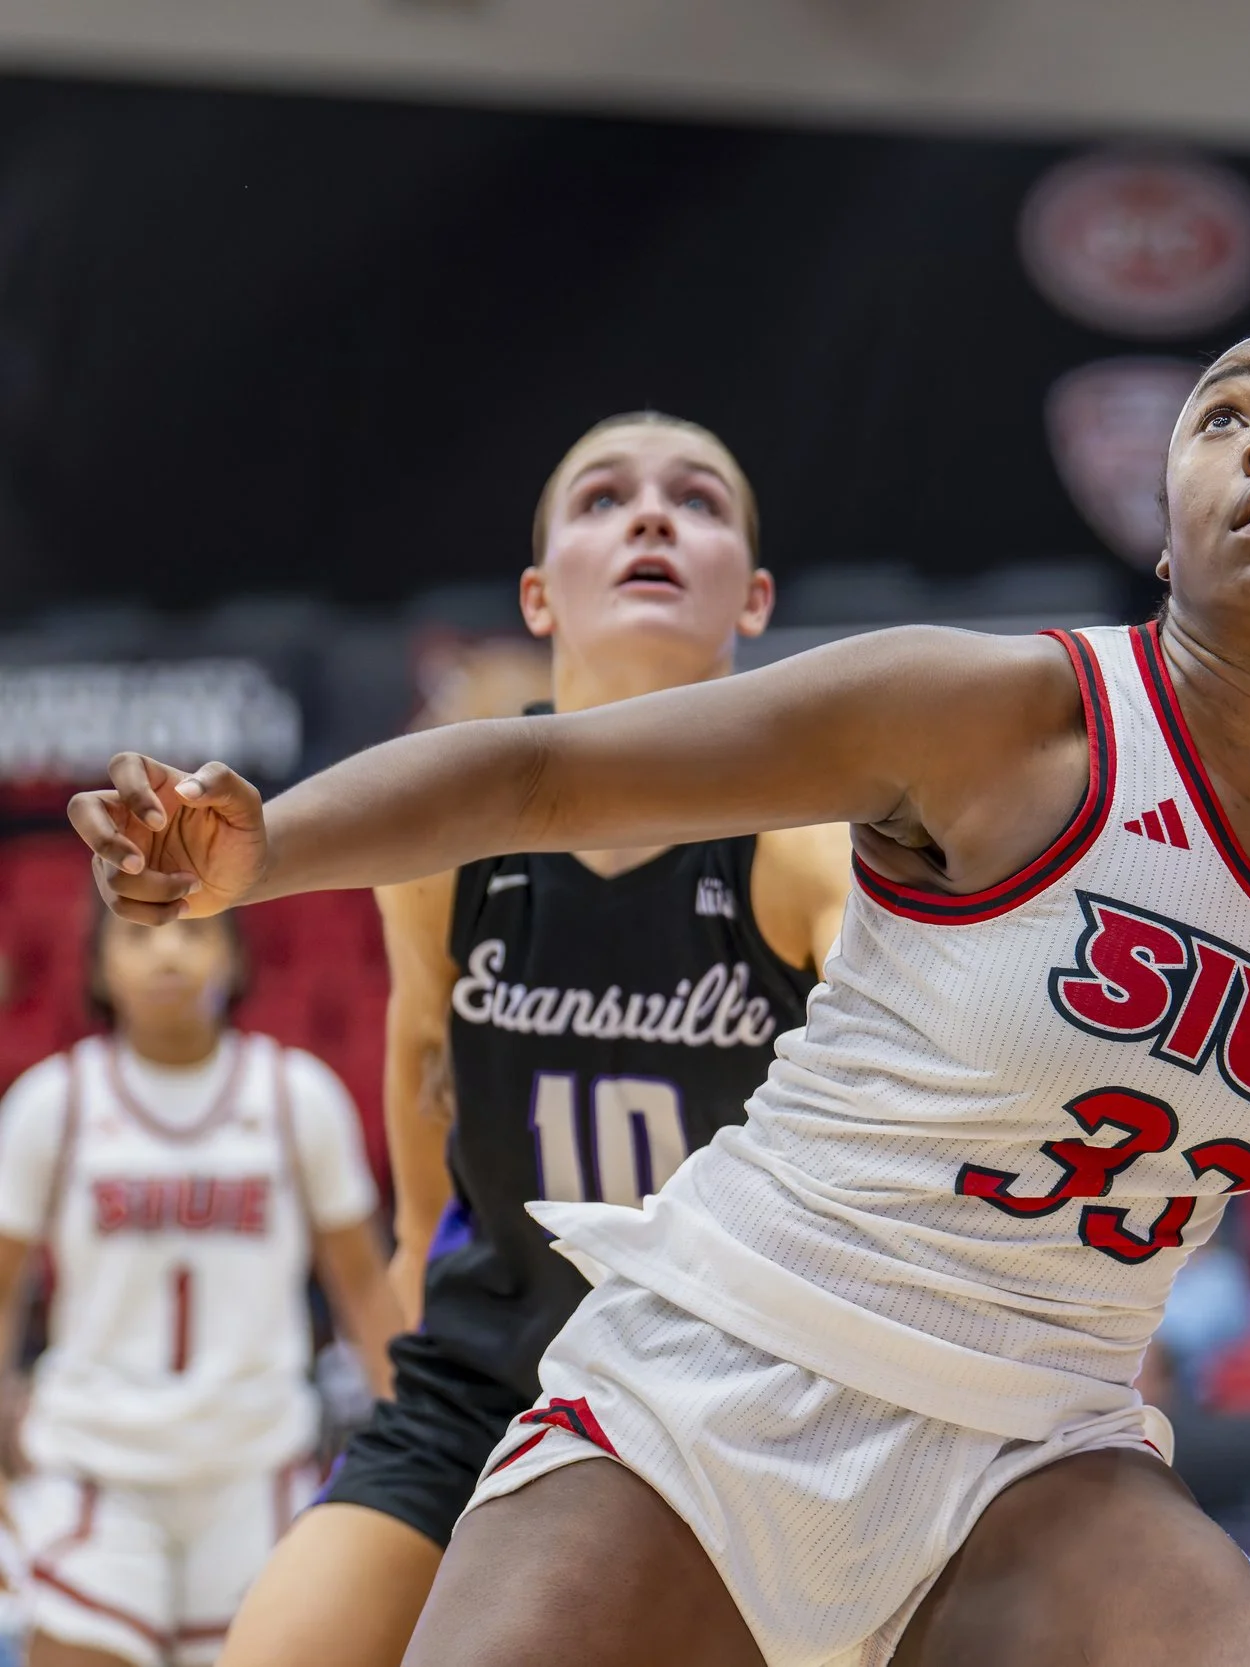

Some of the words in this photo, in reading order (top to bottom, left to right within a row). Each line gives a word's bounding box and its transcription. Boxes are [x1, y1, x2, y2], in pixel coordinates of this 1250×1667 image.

[452, 938, 777, 1048] Evansville
[528, 1070, 690, 1209] 10
[92, 1174, 271, 1238] SIUE
[169, 1261, 192, 1377] 1
